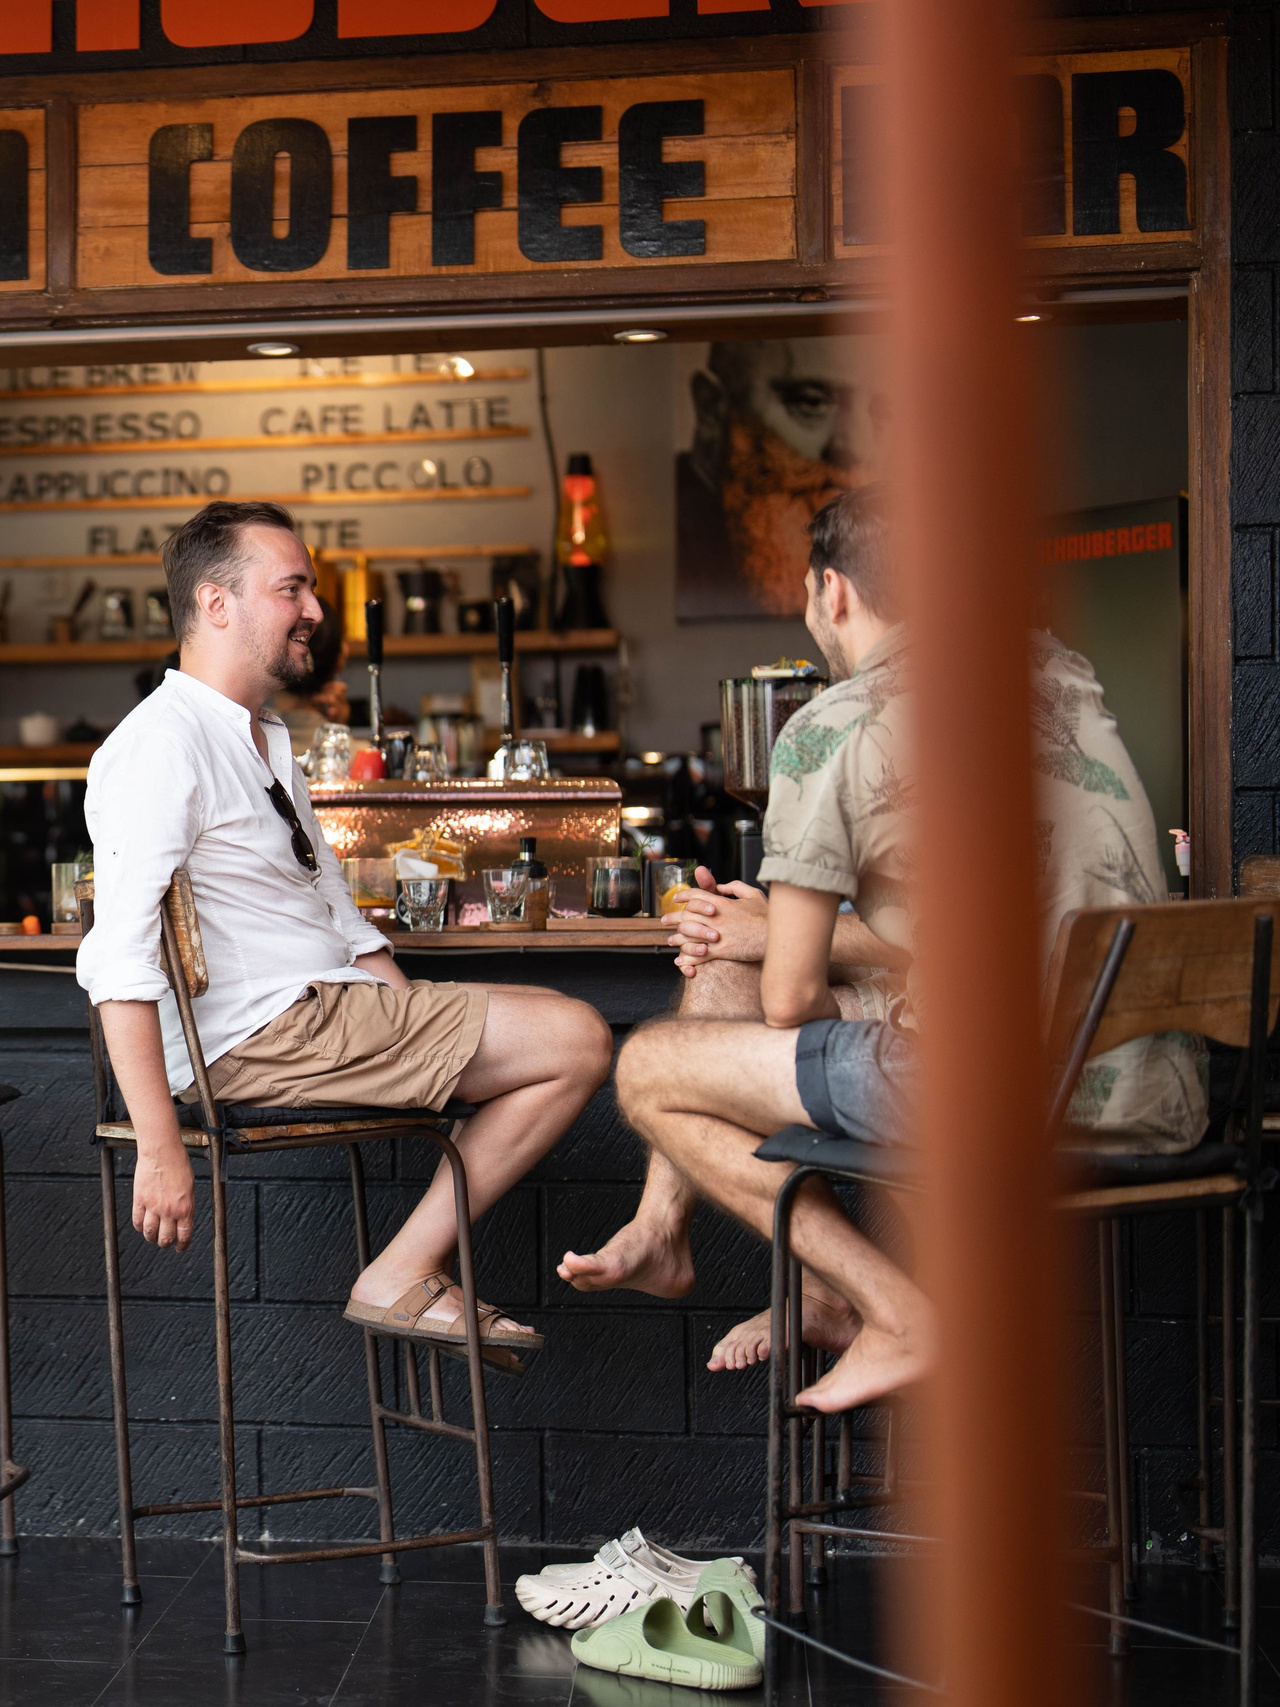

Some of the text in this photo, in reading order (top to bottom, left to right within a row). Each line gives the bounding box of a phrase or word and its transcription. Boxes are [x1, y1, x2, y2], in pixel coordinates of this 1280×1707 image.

[148, 98, 706, 275] COFFEE
[260, 396, 510, 436] CAFE LATTE
[301, 456, 493, 492] PICCOLO
[1038, 521, 1173, 566] CHAUBERGER
